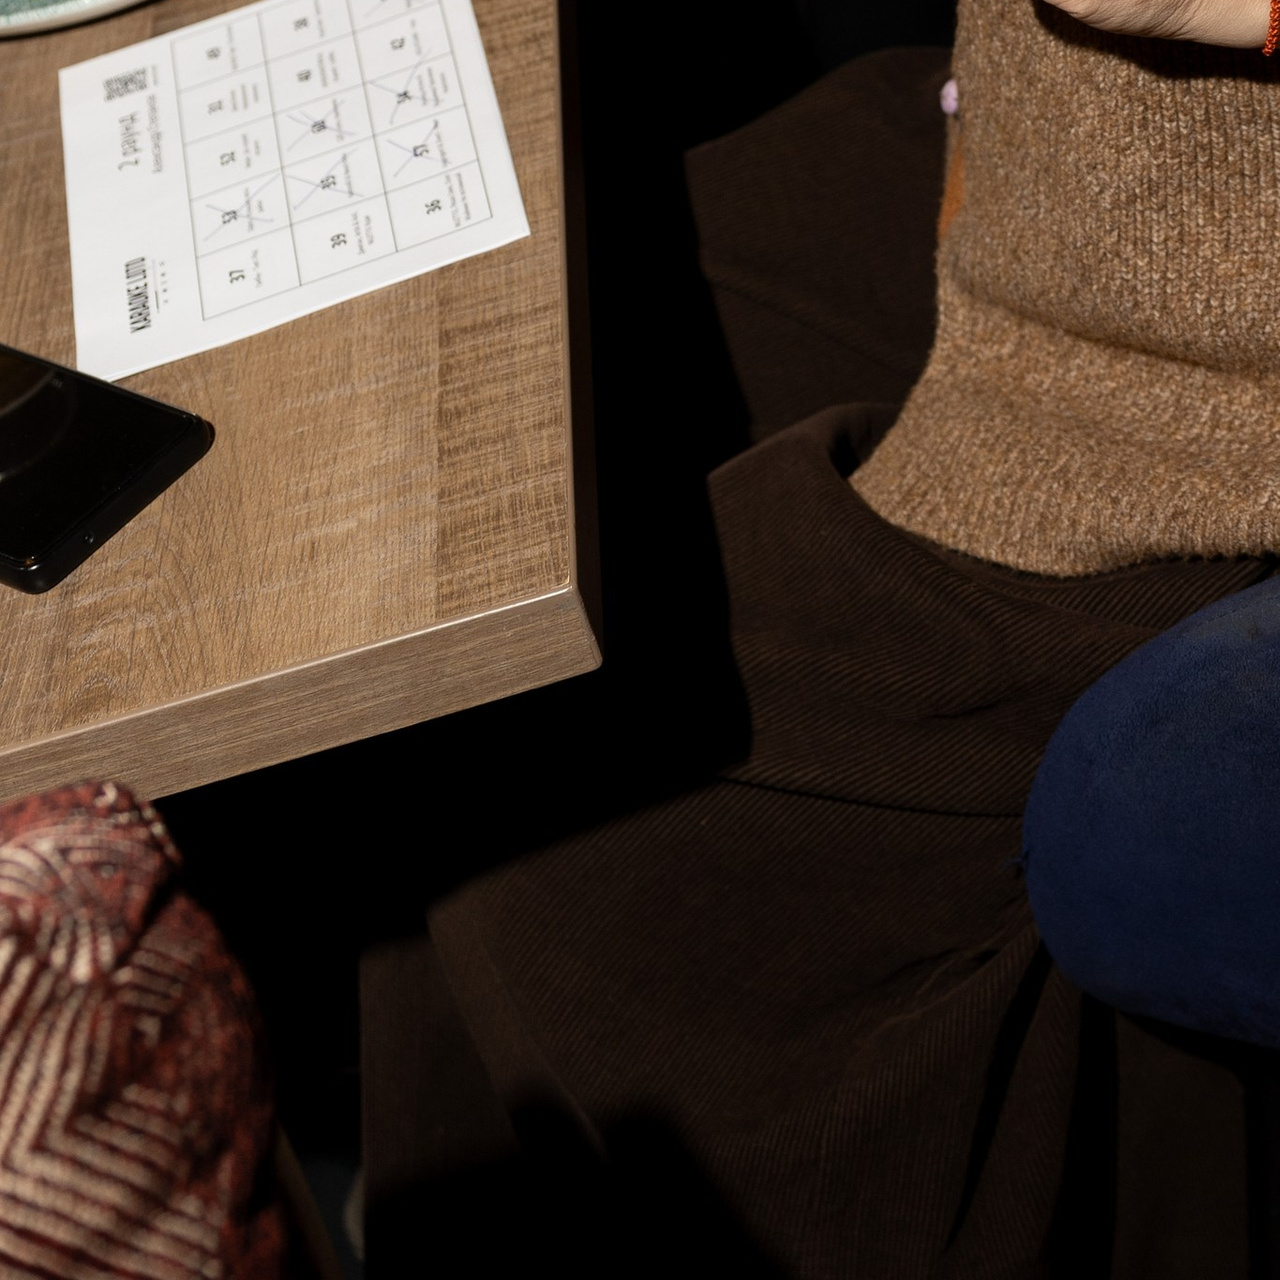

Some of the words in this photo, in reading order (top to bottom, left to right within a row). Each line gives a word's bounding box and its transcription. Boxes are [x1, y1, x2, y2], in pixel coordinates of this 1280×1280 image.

[119, 110, 142, 157] раунд
[117, 158, 139, 171] 2
[425, 200, 442, 214] 36
[331, 233, 347, 248] 39
[124, 257, 147, 285] LOTO
[229, 270, 245, 284] 37
[126, 282, 151, 333] KARAOKE
